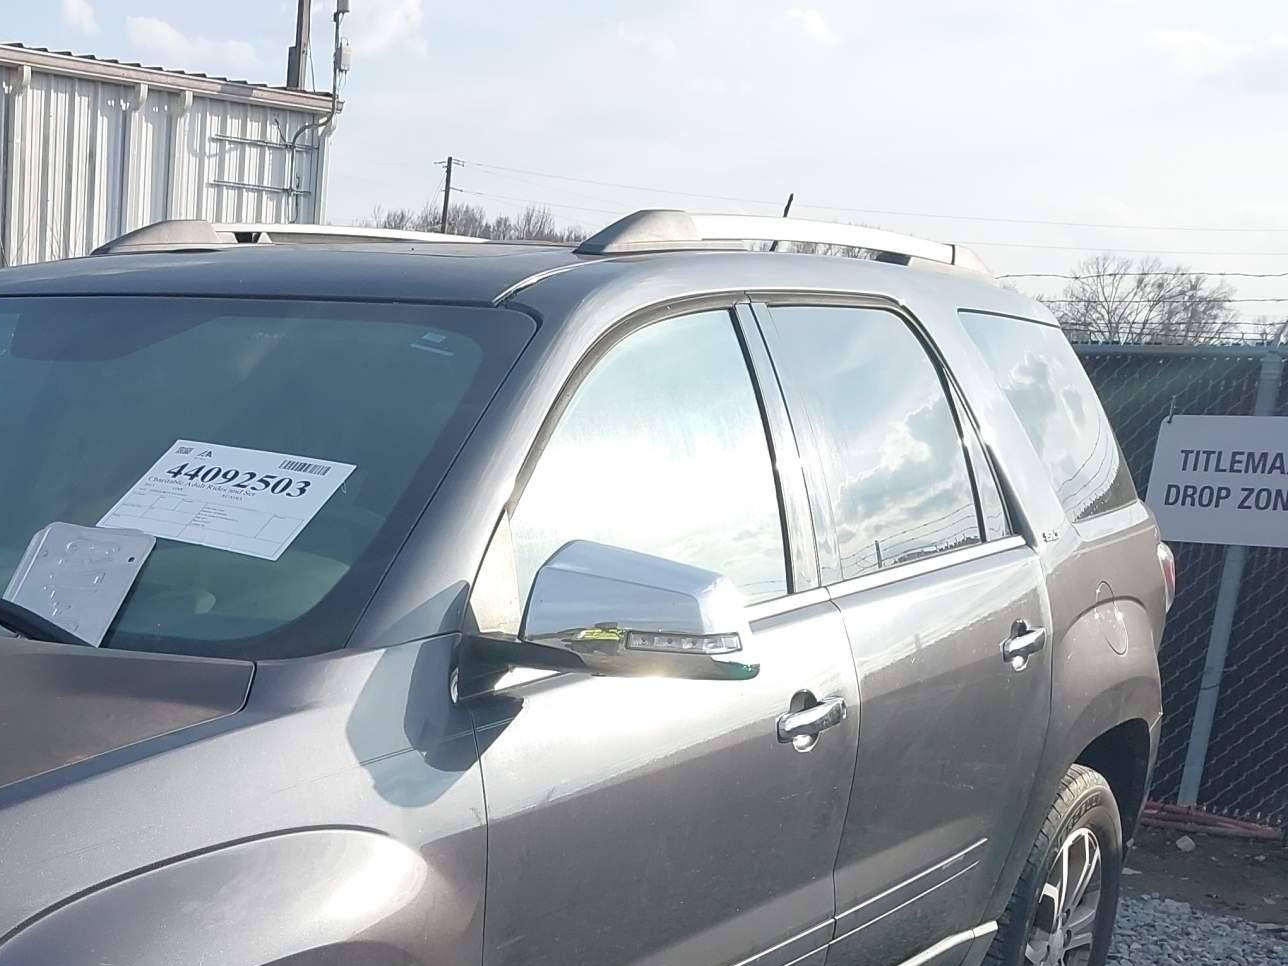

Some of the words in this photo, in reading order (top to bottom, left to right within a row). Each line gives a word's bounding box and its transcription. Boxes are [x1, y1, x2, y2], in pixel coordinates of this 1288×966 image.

[1180, 449, 1288, 475] TITLEMA
[166, 462, 311, 498] 44092503
[1164, 484, 1231, 508] DROP
